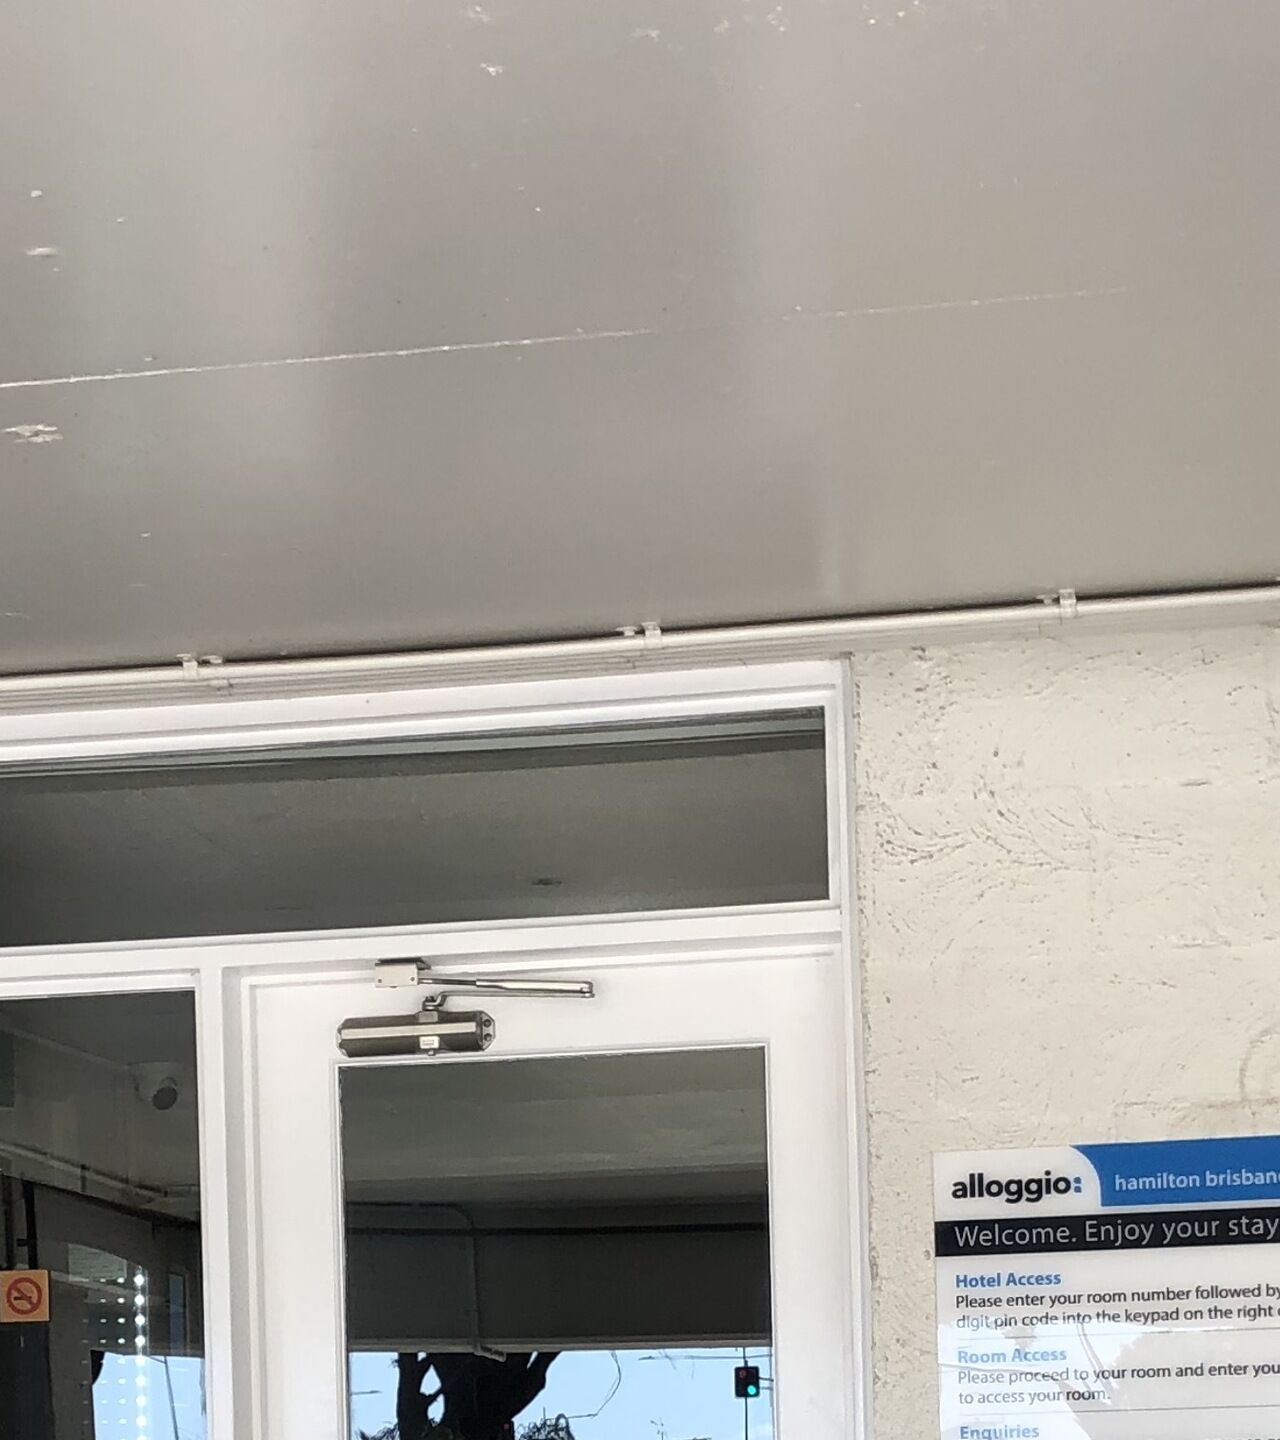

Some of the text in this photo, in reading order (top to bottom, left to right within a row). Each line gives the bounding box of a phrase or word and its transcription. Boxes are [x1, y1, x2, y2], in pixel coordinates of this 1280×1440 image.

[1115, 1172, 1200, 1192] hamilton
[954, 1224, 1077, 1247] Welcome.
[1085, 1220, 1154, 1246] Enjoy
[1162, 1220, 1220, 1245] your
[955, 1273, 1061, 1288] Hotel Access
[955, 1295, 1003, 1308] Please
[1006, 1294, 1045, 1307] enter
[1049, 1293, 1083, 1308] your
[1087, 1291, 1126, 1303] room
[1131, 1287, 1190, 1301] number
[1196, 1284, 1261, 1299] followed
[956, 1315, 992, 1330] digit
[994, 1314, 1017, 1328] pin
[1022, 1311, 1058, 1327] code
[1063, 1311, 1092, 1325] into
[1096, 1309, 1120, 1322] the
[1125, 1308, 1179, 1325] keypad
[1183, 1308, 1203, 1320] on
[1209, 1306, 1232, 1319] the
[1237, 1304, 1274, 1321] right
[958, 1348, 1067, 1364] Room Access
[958, 1370, 1004, 1384] Please
[1009, 1368, 1069, 1385] proceed
[1074, 1368, 1089, 1381] to
[1093, 1368, 1127, 1383] your
[1131, 1366, 1171, 1378] room
[1175, 1363, 1204, 1377] and
[1208, 1363, 1248, 1376] enter
[959, 1389, 1110, 1405] to access your room.
